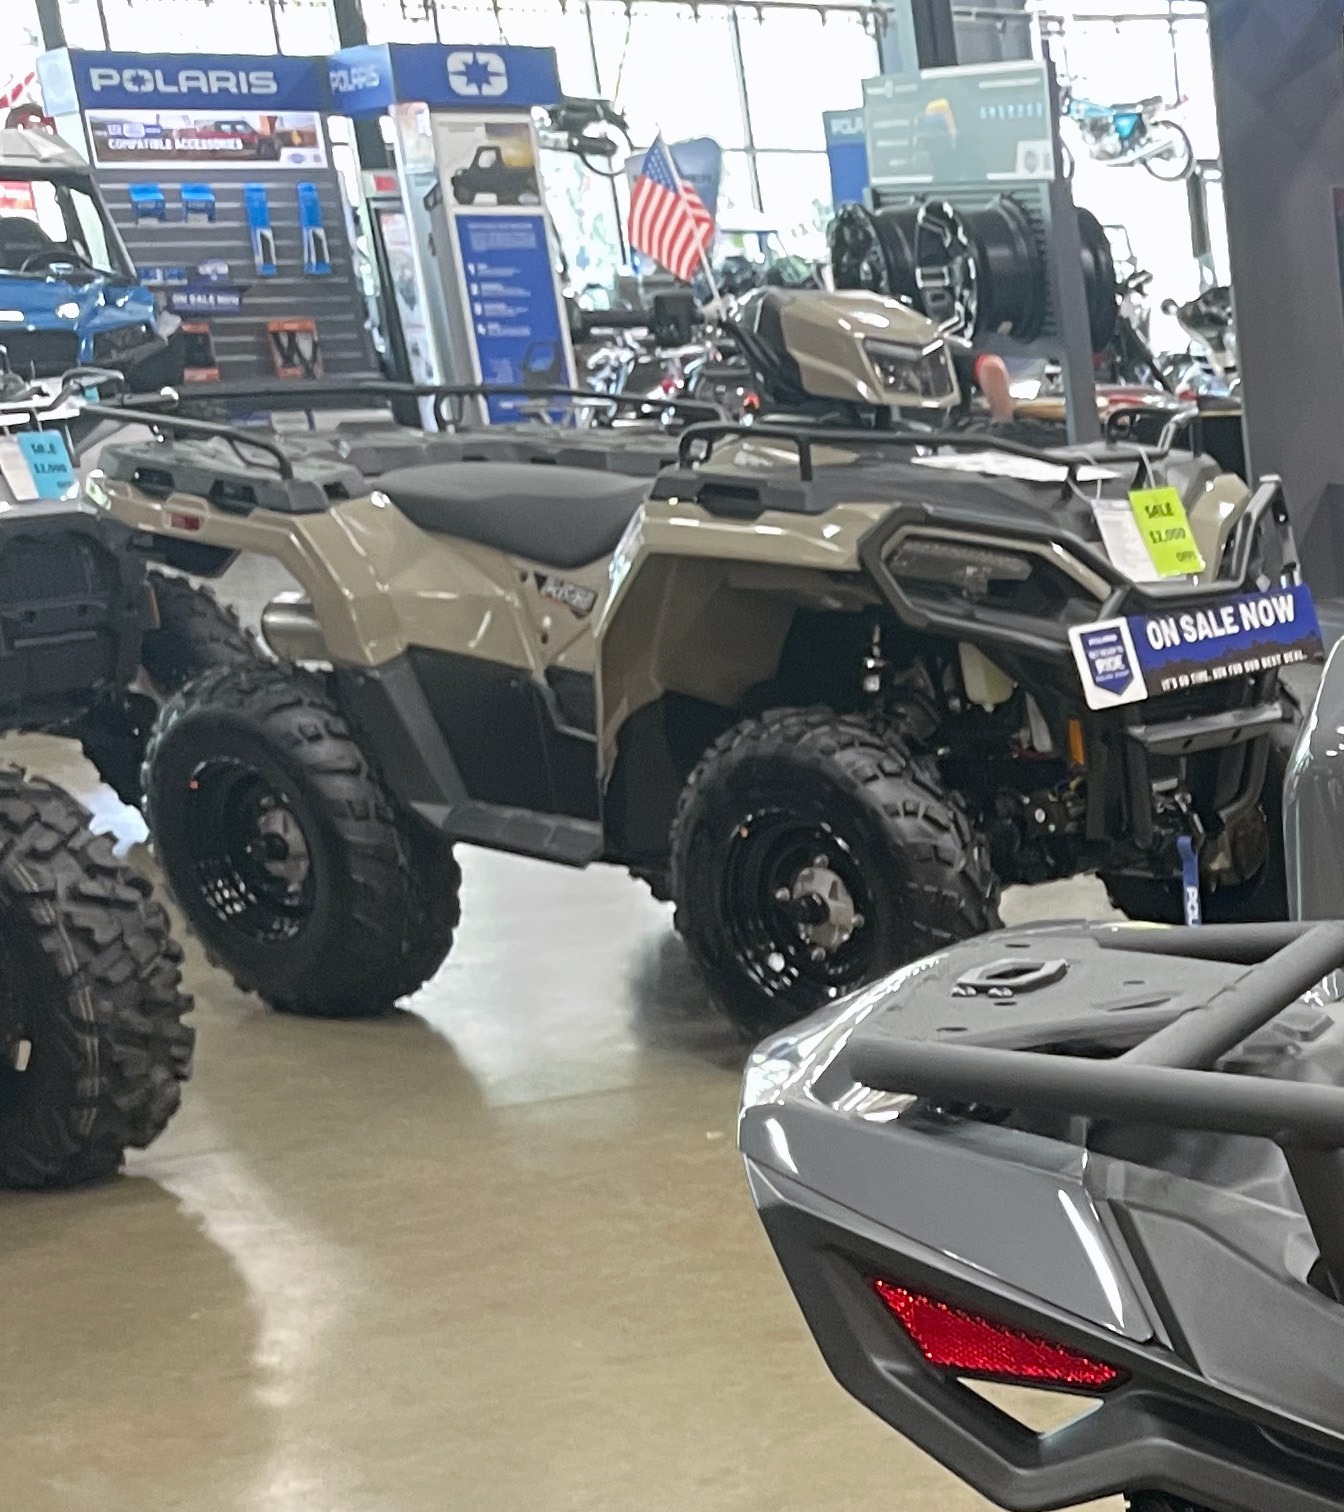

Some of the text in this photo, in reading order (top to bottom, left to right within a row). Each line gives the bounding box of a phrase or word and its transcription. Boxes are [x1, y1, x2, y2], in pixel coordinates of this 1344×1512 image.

[90, 67, 279, 95] POLARIS
[1144, 502, 1174, 519] SALE
[1146, 593, 1295, 651] ON SALE NOW
